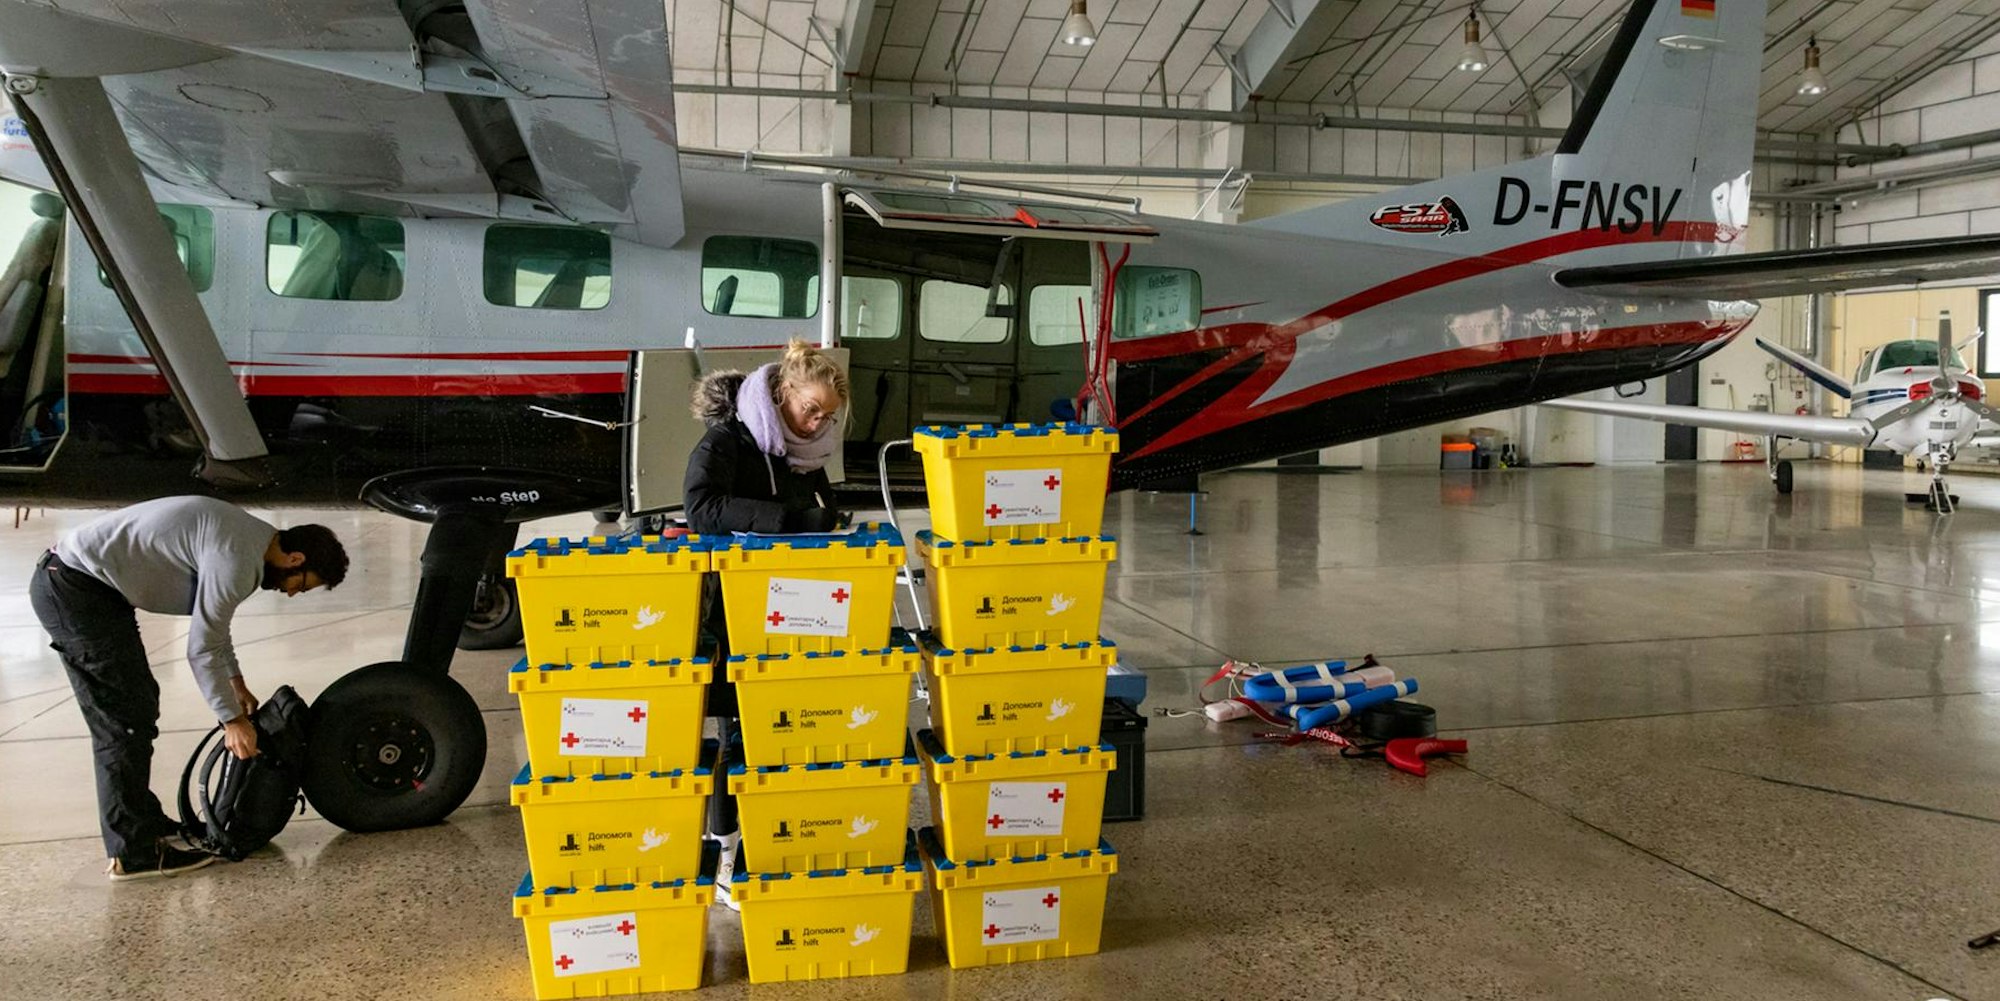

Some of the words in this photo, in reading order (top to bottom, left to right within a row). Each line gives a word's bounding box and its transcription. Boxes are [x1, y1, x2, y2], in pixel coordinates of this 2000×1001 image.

[1493, 177, 1682, 236] D-FNSV
[1373, 203, 1444, 220] FSZ
[500, 490, 540, 504] Step
[1002, 595, 1043, 604] Допомога
[583, 608, 628, 617] Допомога
[1002, 607, 1017, 615] hilft
[583, 620, 601, 628] hilft
[1002, 702, 1043, 711] Допомога
[800, 709, 843, 718] Допомога
[1002, 713, 1018, 721] hilft
[800, 819, 842, 828] Допомога
[588, 832, 632, 841] Допомога
[800, 830, 816, 838] hilft
[589, 844, 605, 852] hilft
[802, 927, 845, 936] Допомога
